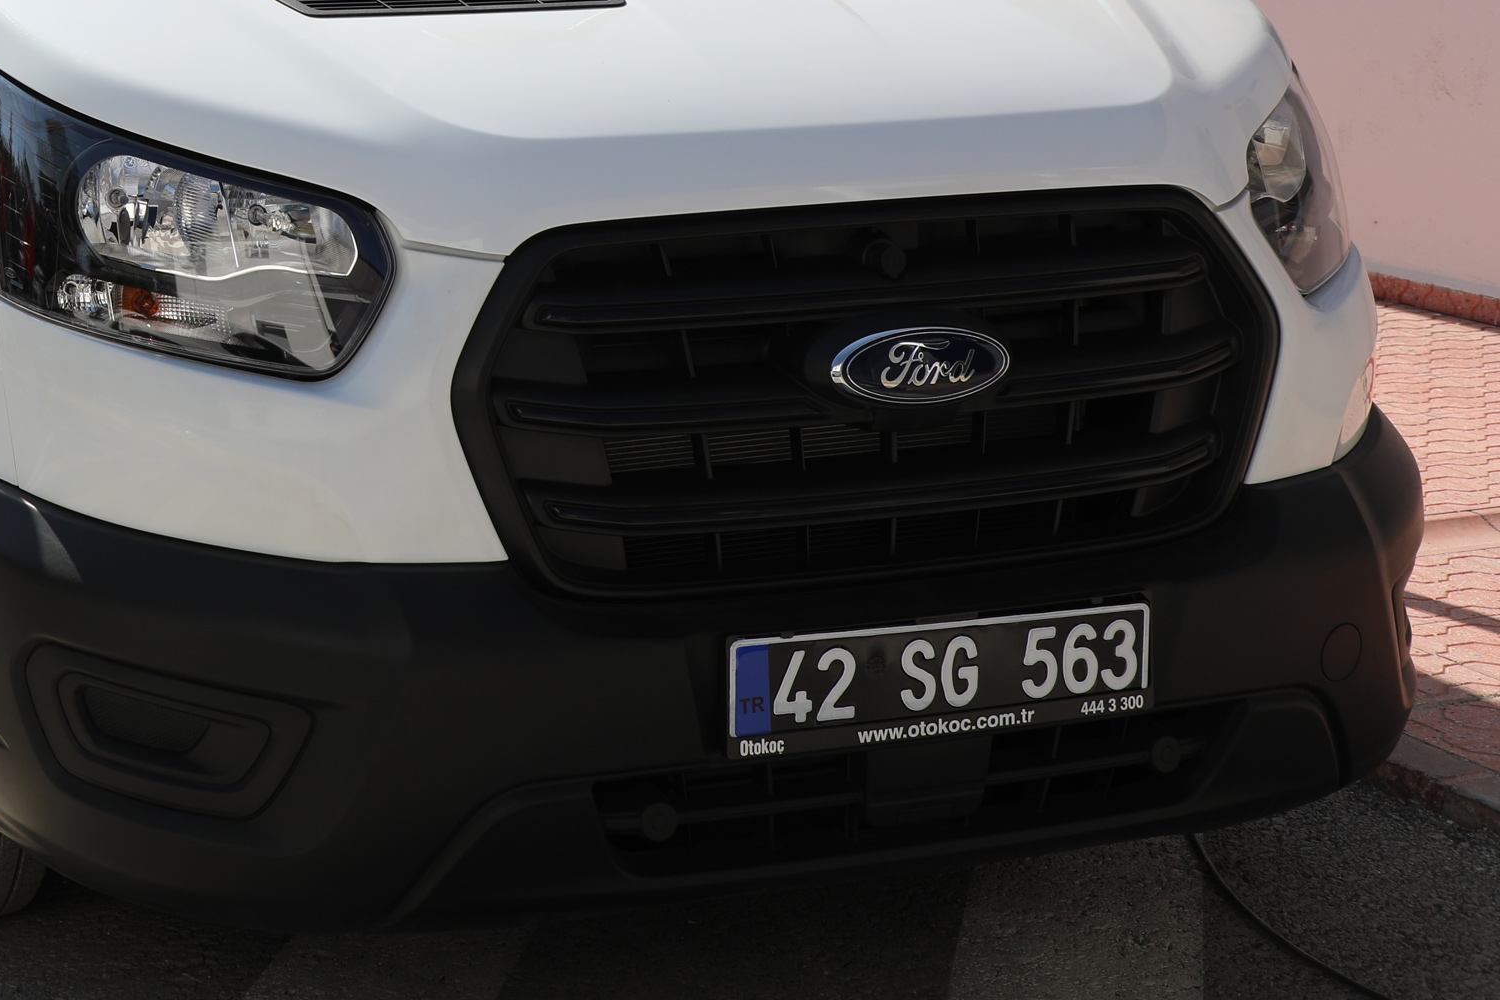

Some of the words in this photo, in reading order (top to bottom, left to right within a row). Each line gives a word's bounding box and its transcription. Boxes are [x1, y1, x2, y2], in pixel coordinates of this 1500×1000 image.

[880, 341, 975, 388] Ford
[773, 647, 857, 724] 42
[900, 635, 979, 712] SG
[1021, 618, 1138, 699] 563
[739, 696, 765, 715] TR
[1080, 698, 1105, 715] 444
[1108, 697, 1117, 712] 3
[1120, 694, 1145, 711] 300
[857, 708, 1035, 744] www.otokoc.com.tr
[739, 738, 785, 757] Otokoç
